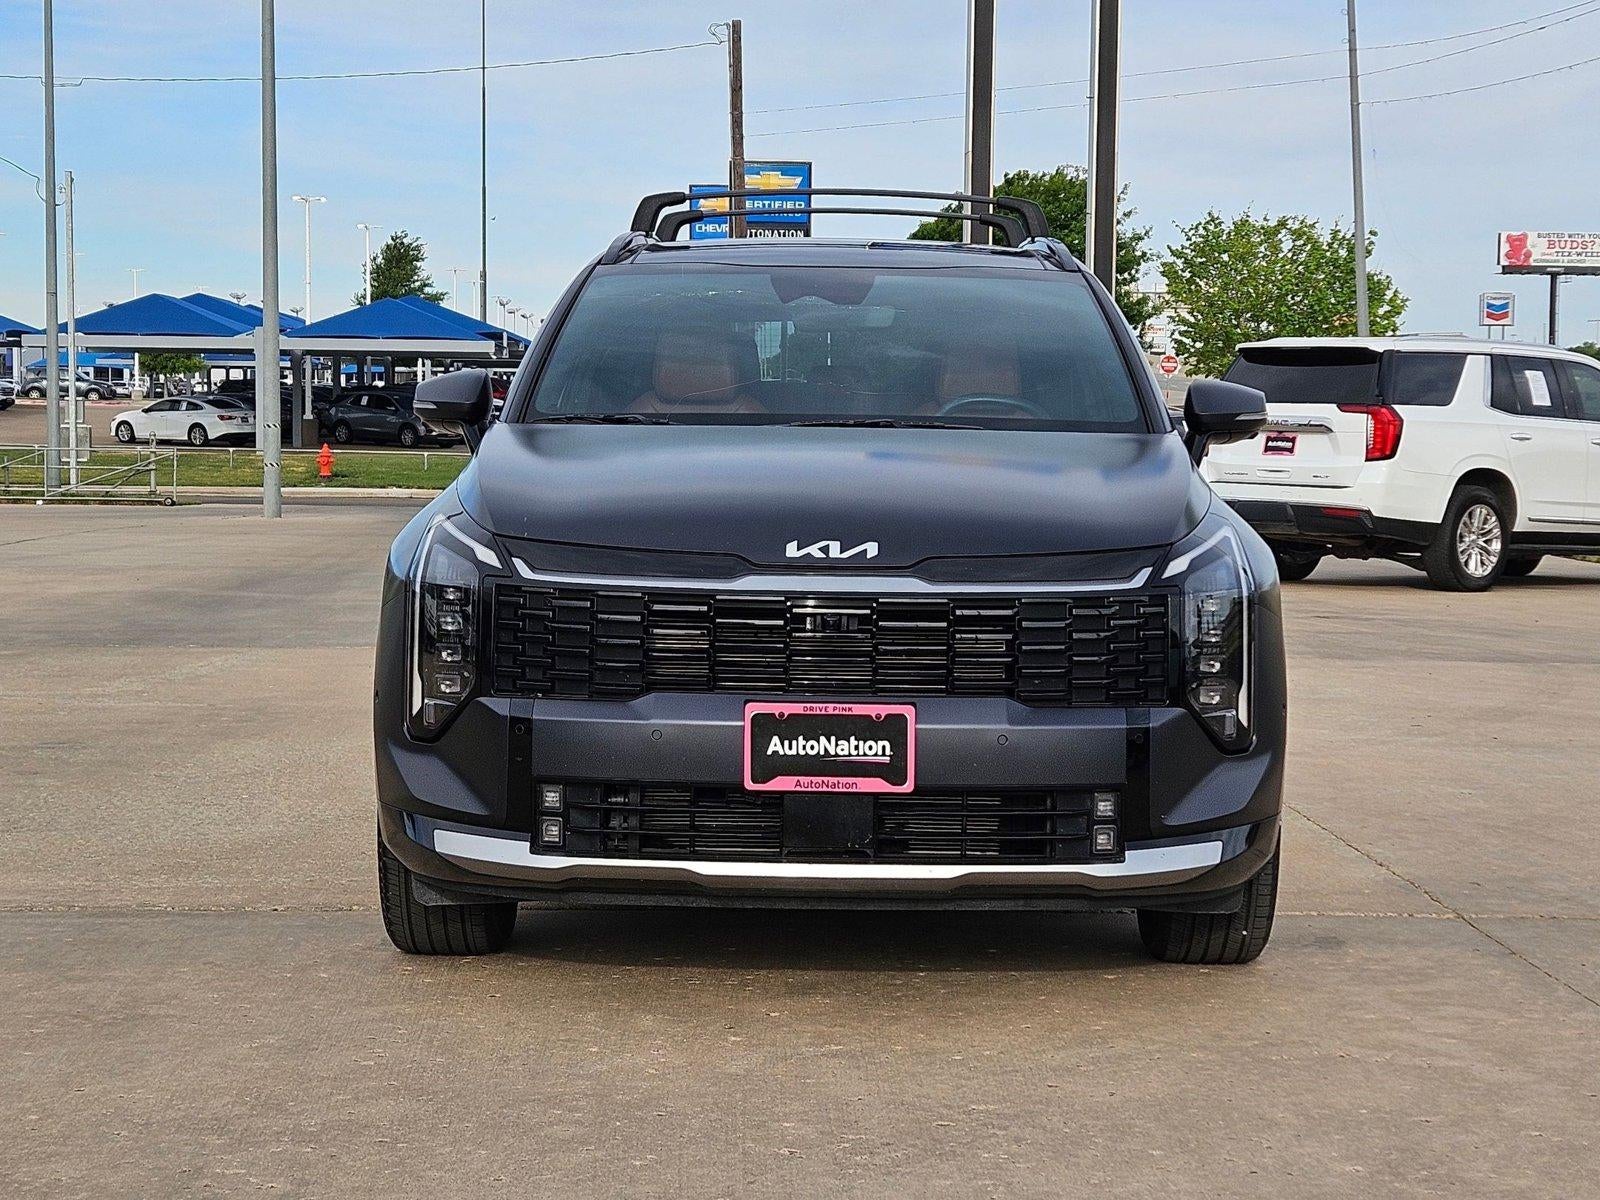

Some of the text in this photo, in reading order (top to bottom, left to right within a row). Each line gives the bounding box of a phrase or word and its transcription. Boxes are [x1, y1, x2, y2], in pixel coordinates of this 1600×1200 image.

[1546, 239, 1596, 250] BUDS?
[785, 540, 879, 559] KIA
[803, 705, 830, 713] DRIVE
